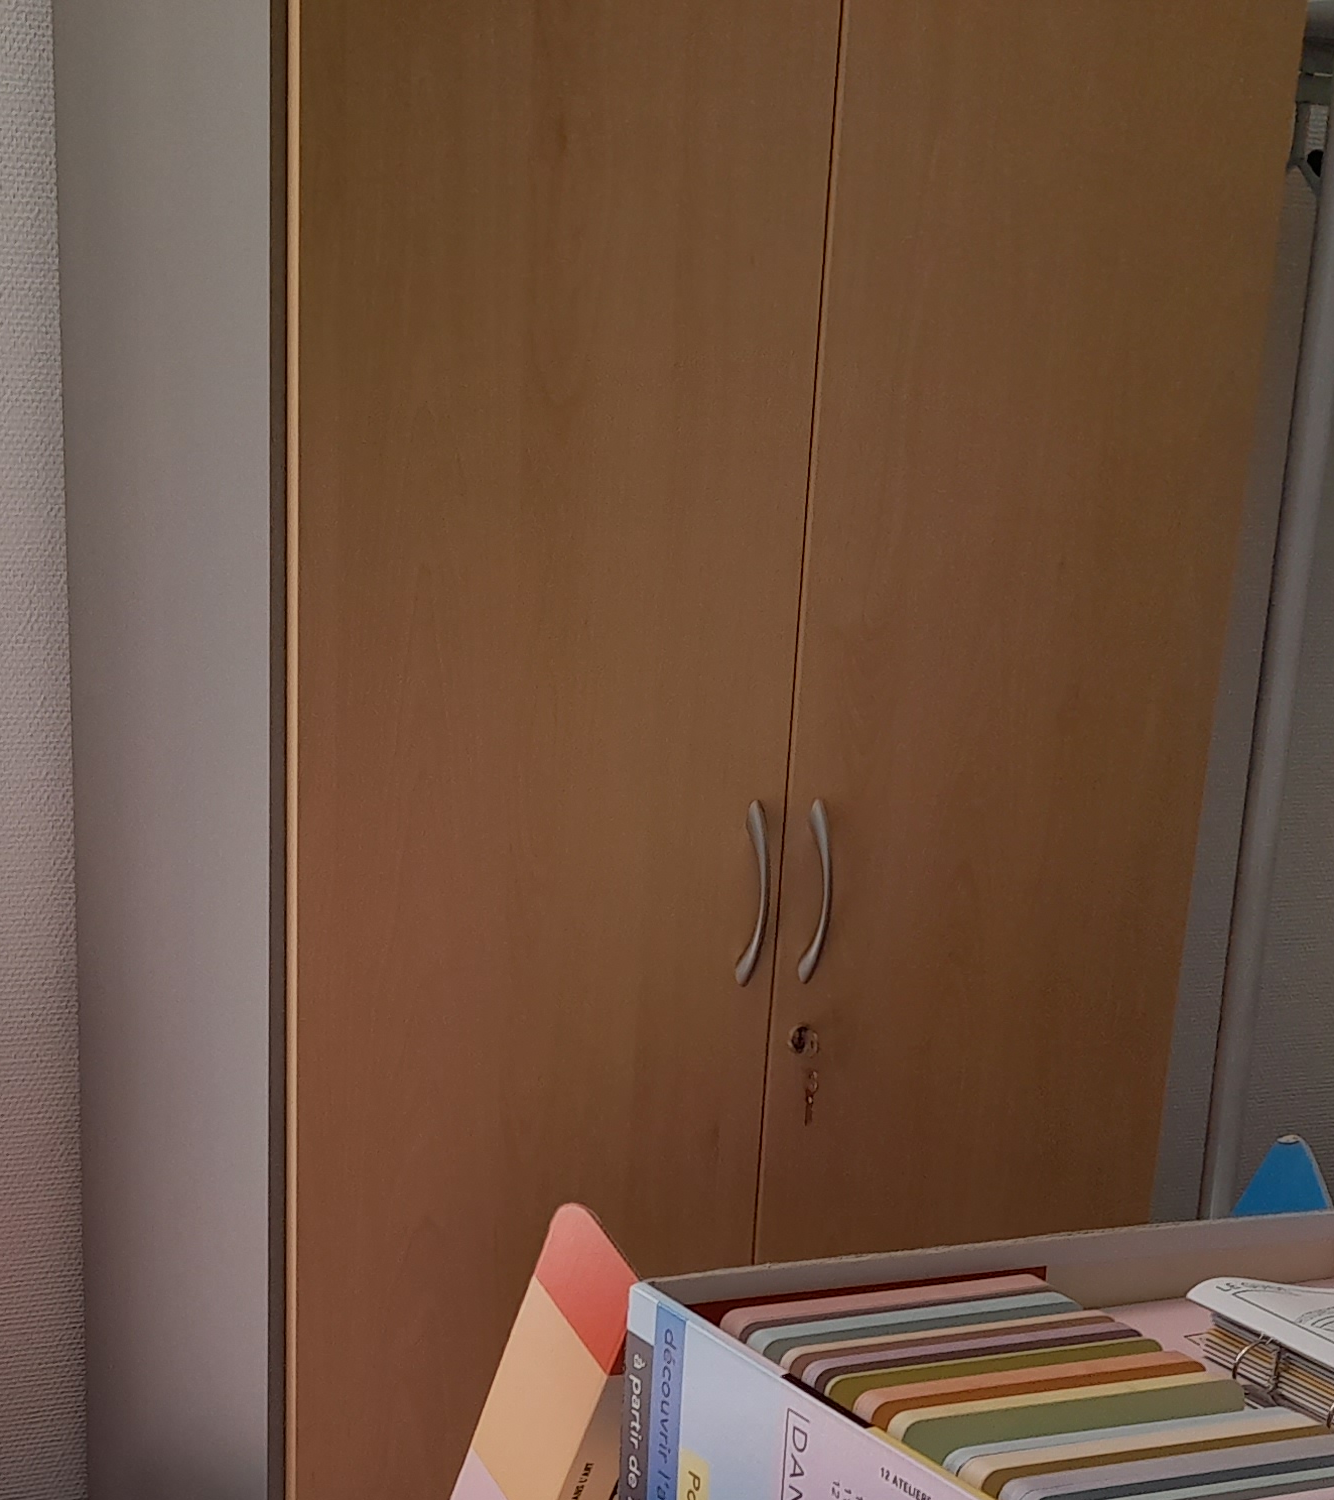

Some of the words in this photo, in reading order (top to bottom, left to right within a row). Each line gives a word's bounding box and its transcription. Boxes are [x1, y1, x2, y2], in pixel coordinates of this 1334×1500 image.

[632, 1353, 646, 1370] à
[628, 1374, 643, 1449] partir
[657, 1326, 678, 1465] découvrir
[627, 1454, 642, 1490] de
[880, 1467, 890, 1481] 12
